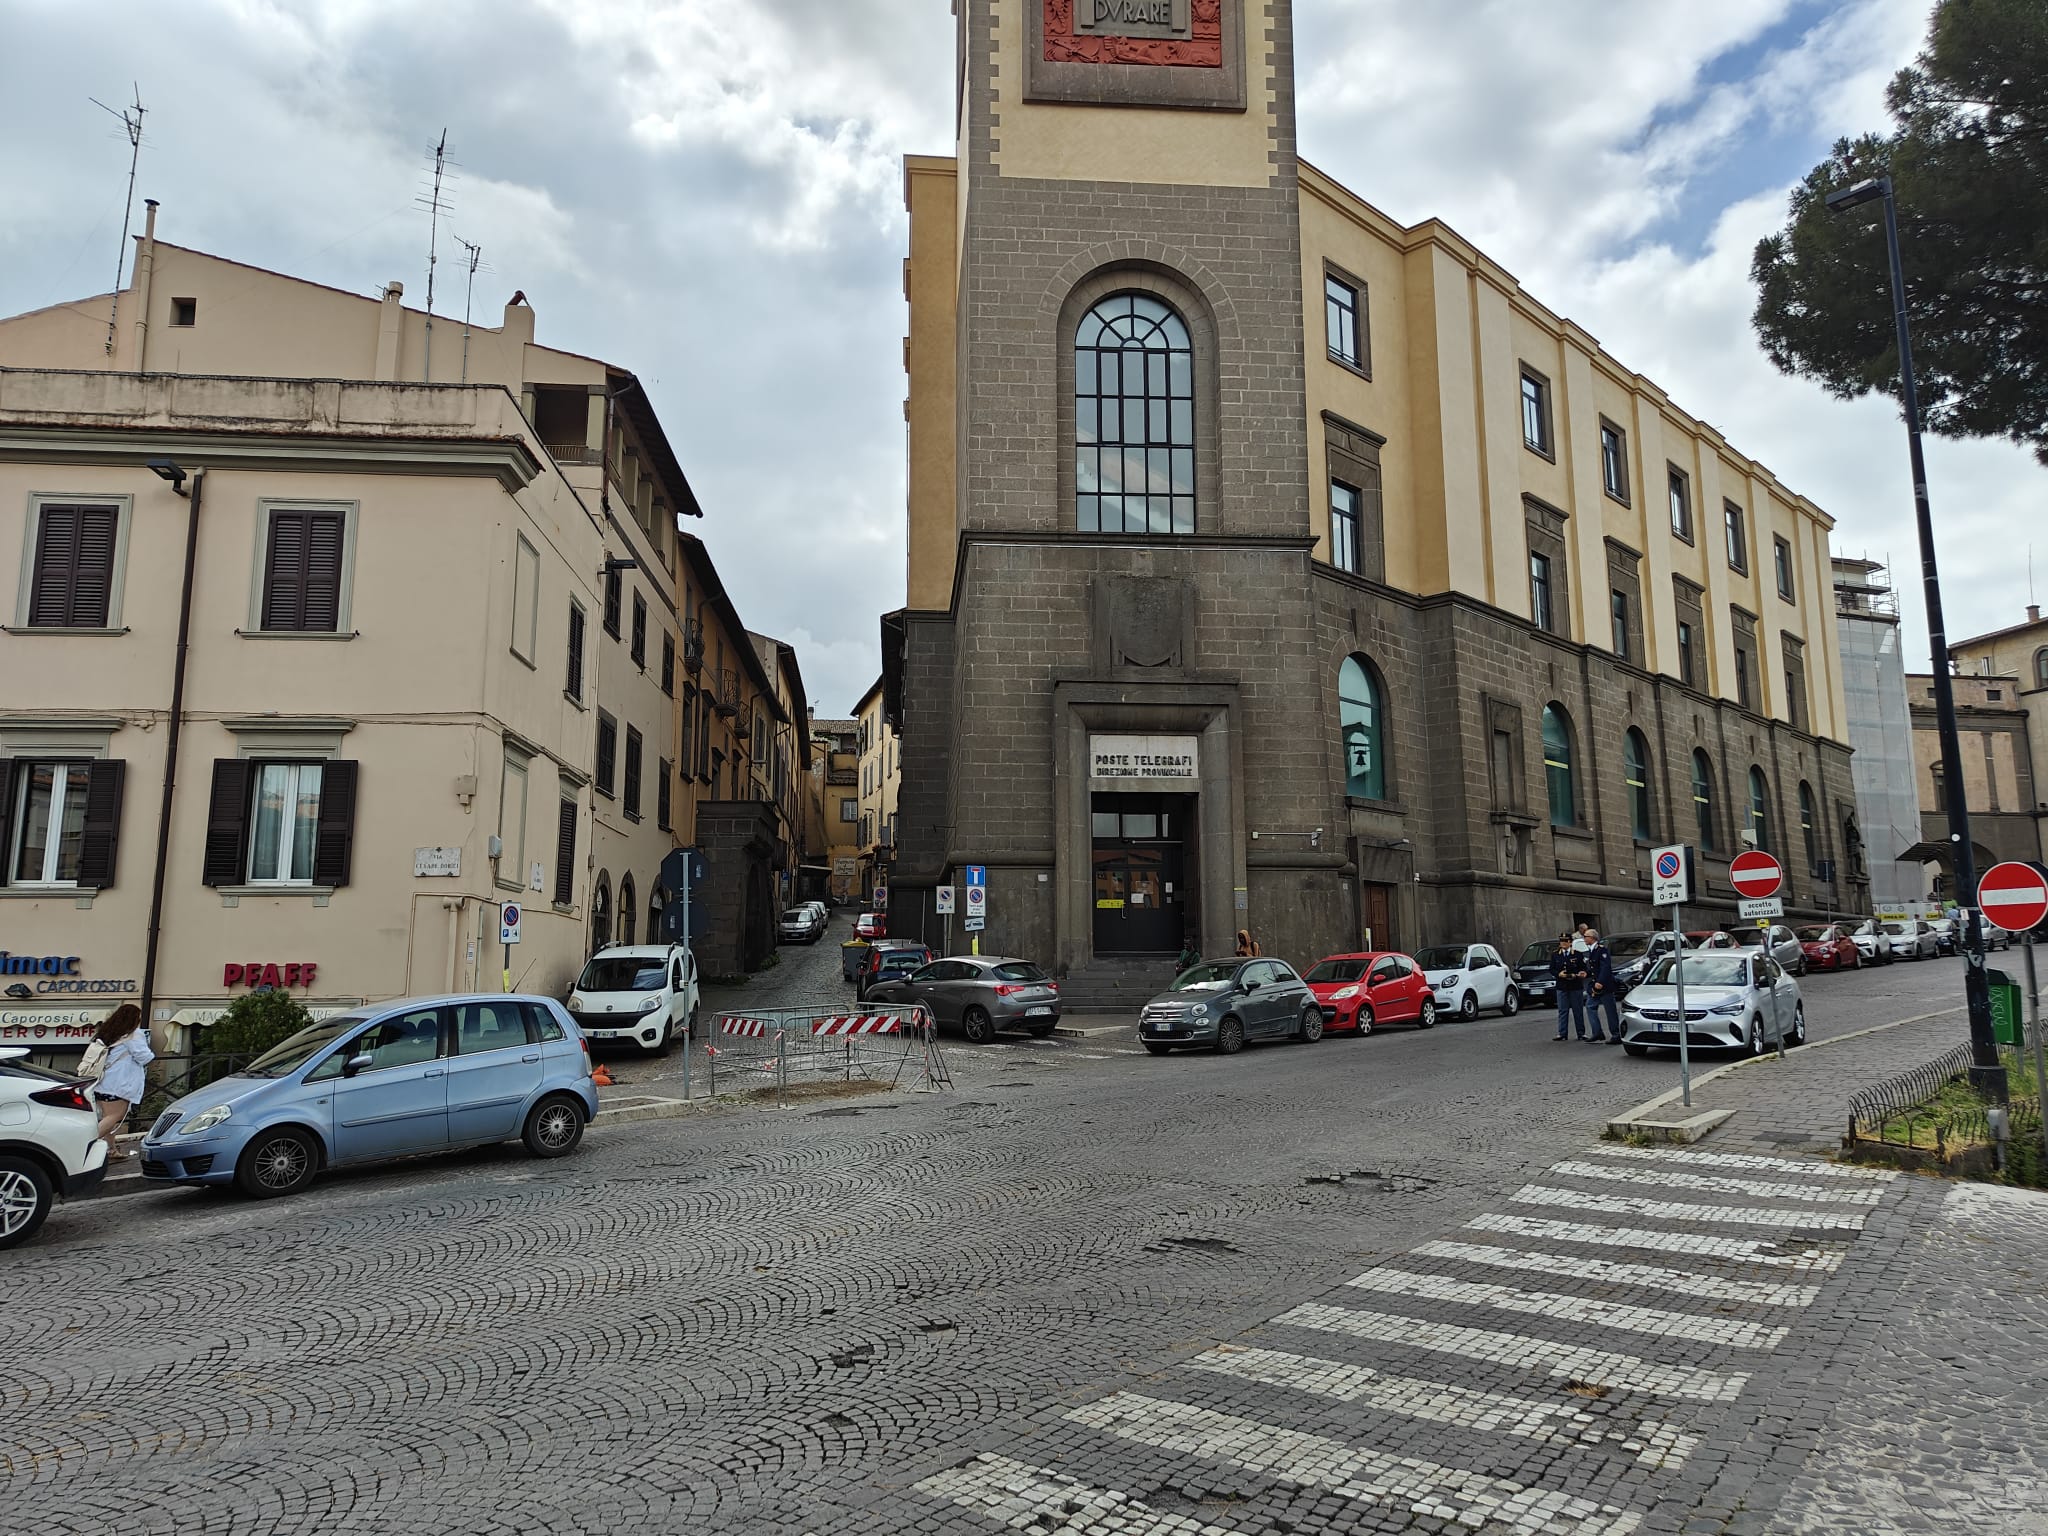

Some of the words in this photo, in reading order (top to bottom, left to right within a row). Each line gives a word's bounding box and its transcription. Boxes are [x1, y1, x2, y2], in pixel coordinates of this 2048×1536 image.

[1096, 755, 1129, 765] POSTE
[1134, 755, 1192, 766] TELEGRAFI
[1096, 768, 1139, 776] DIREZIONE
[1141, 768, 1192, 777] PROVINCIALE
[1660, 892, 1679, 900] 0-24
[1748, 901, 1772, 909] eccetto
[1743, 908, 1780, 917] autorizzati
[223, 963, 317, 988] PFAFF
[36, 980, 121, 993] CAPOROSSI
[2, 1011, 74, 1024] Caporossi
